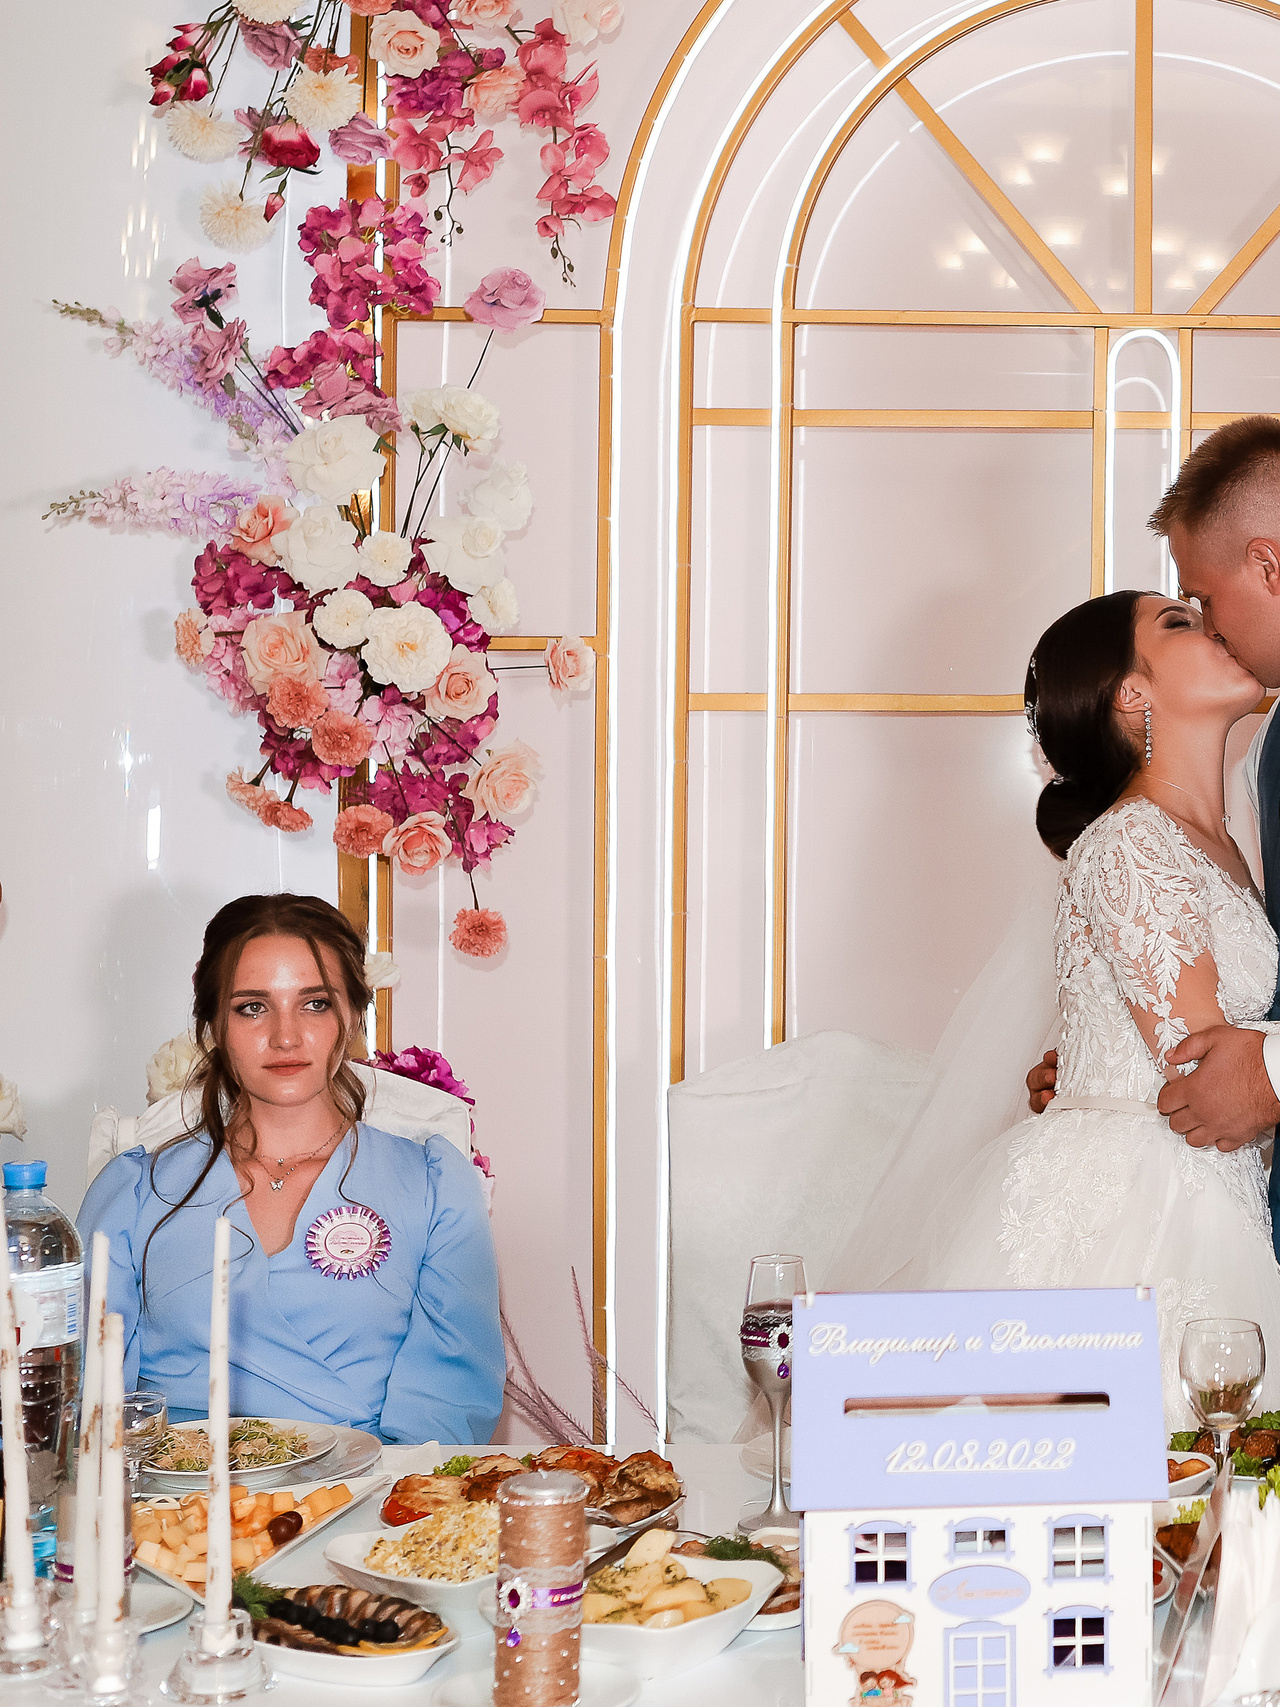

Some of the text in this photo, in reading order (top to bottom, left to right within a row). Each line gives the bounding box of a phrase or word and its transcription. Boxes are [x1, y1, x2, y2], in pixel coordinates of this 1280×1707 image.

[809, 1320, 1144, 1365] Владимир и Виолетта
[885, 1438, 1076, 1473] 12.08.2022
